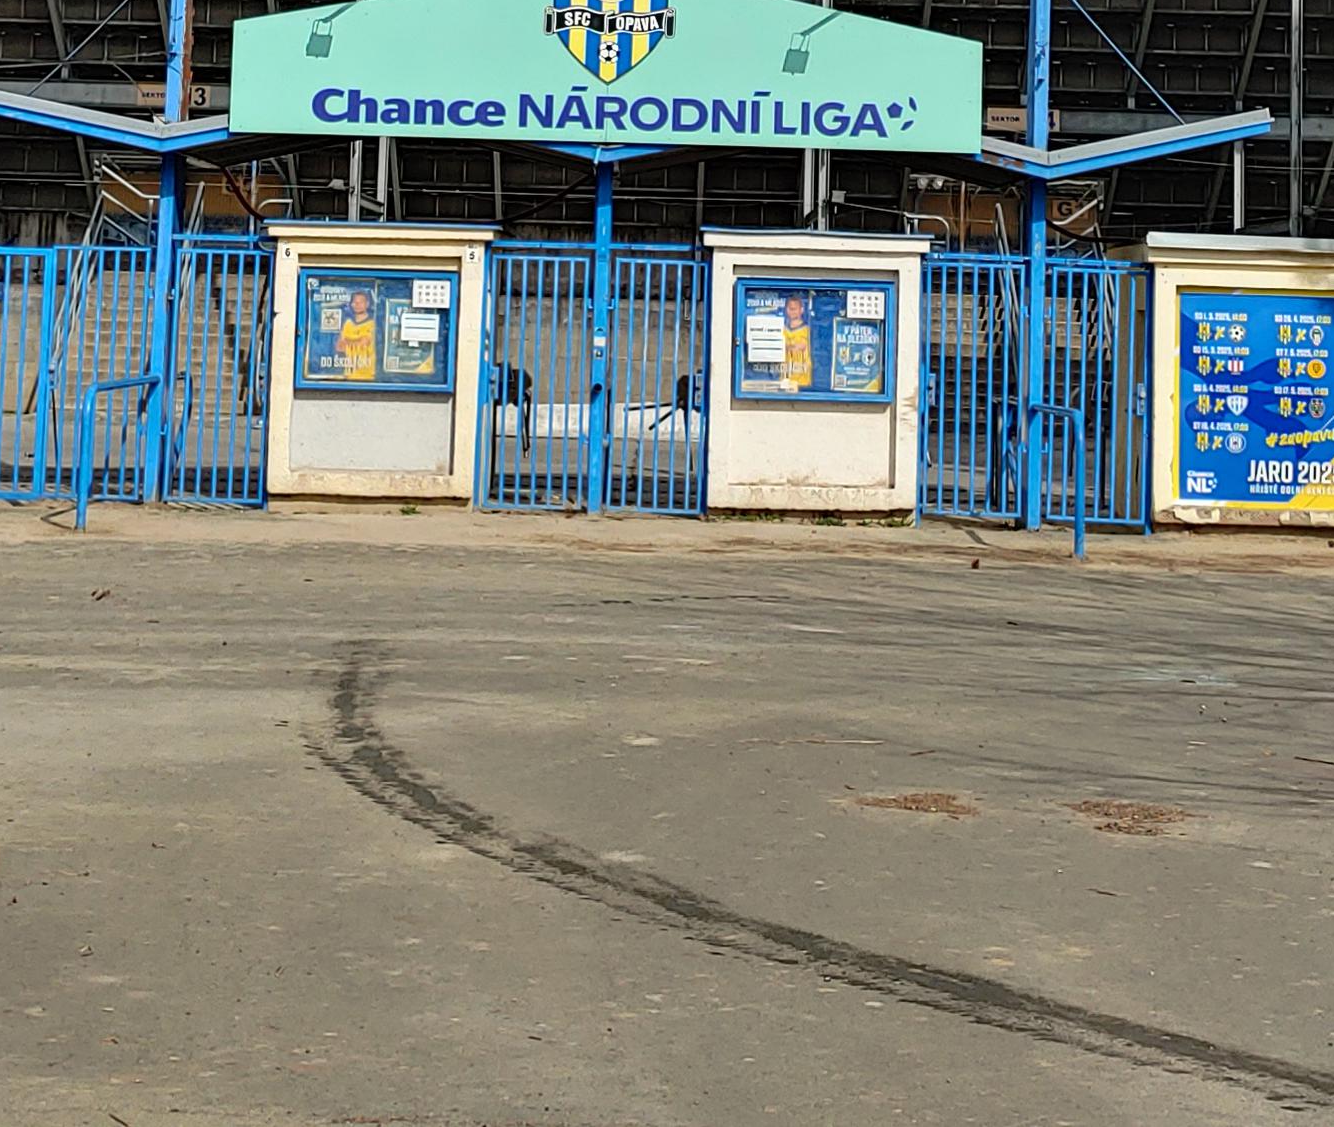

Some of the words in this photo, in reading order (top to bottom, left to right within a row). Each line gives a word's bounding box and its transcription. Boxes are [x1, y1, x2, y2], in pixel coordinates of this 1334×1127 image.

[564, 11, 591, 26] SFC
[615, 15, 659, 32] OPAVA
[311, 87, 506, 128] Chance
[517, 85, 770, 137] NÁRODNÍ
[773, 100, 889, 139] LIGA
[1247, 459, 1294, 483] JARO
[1187, 477, 1213, 493] NL
